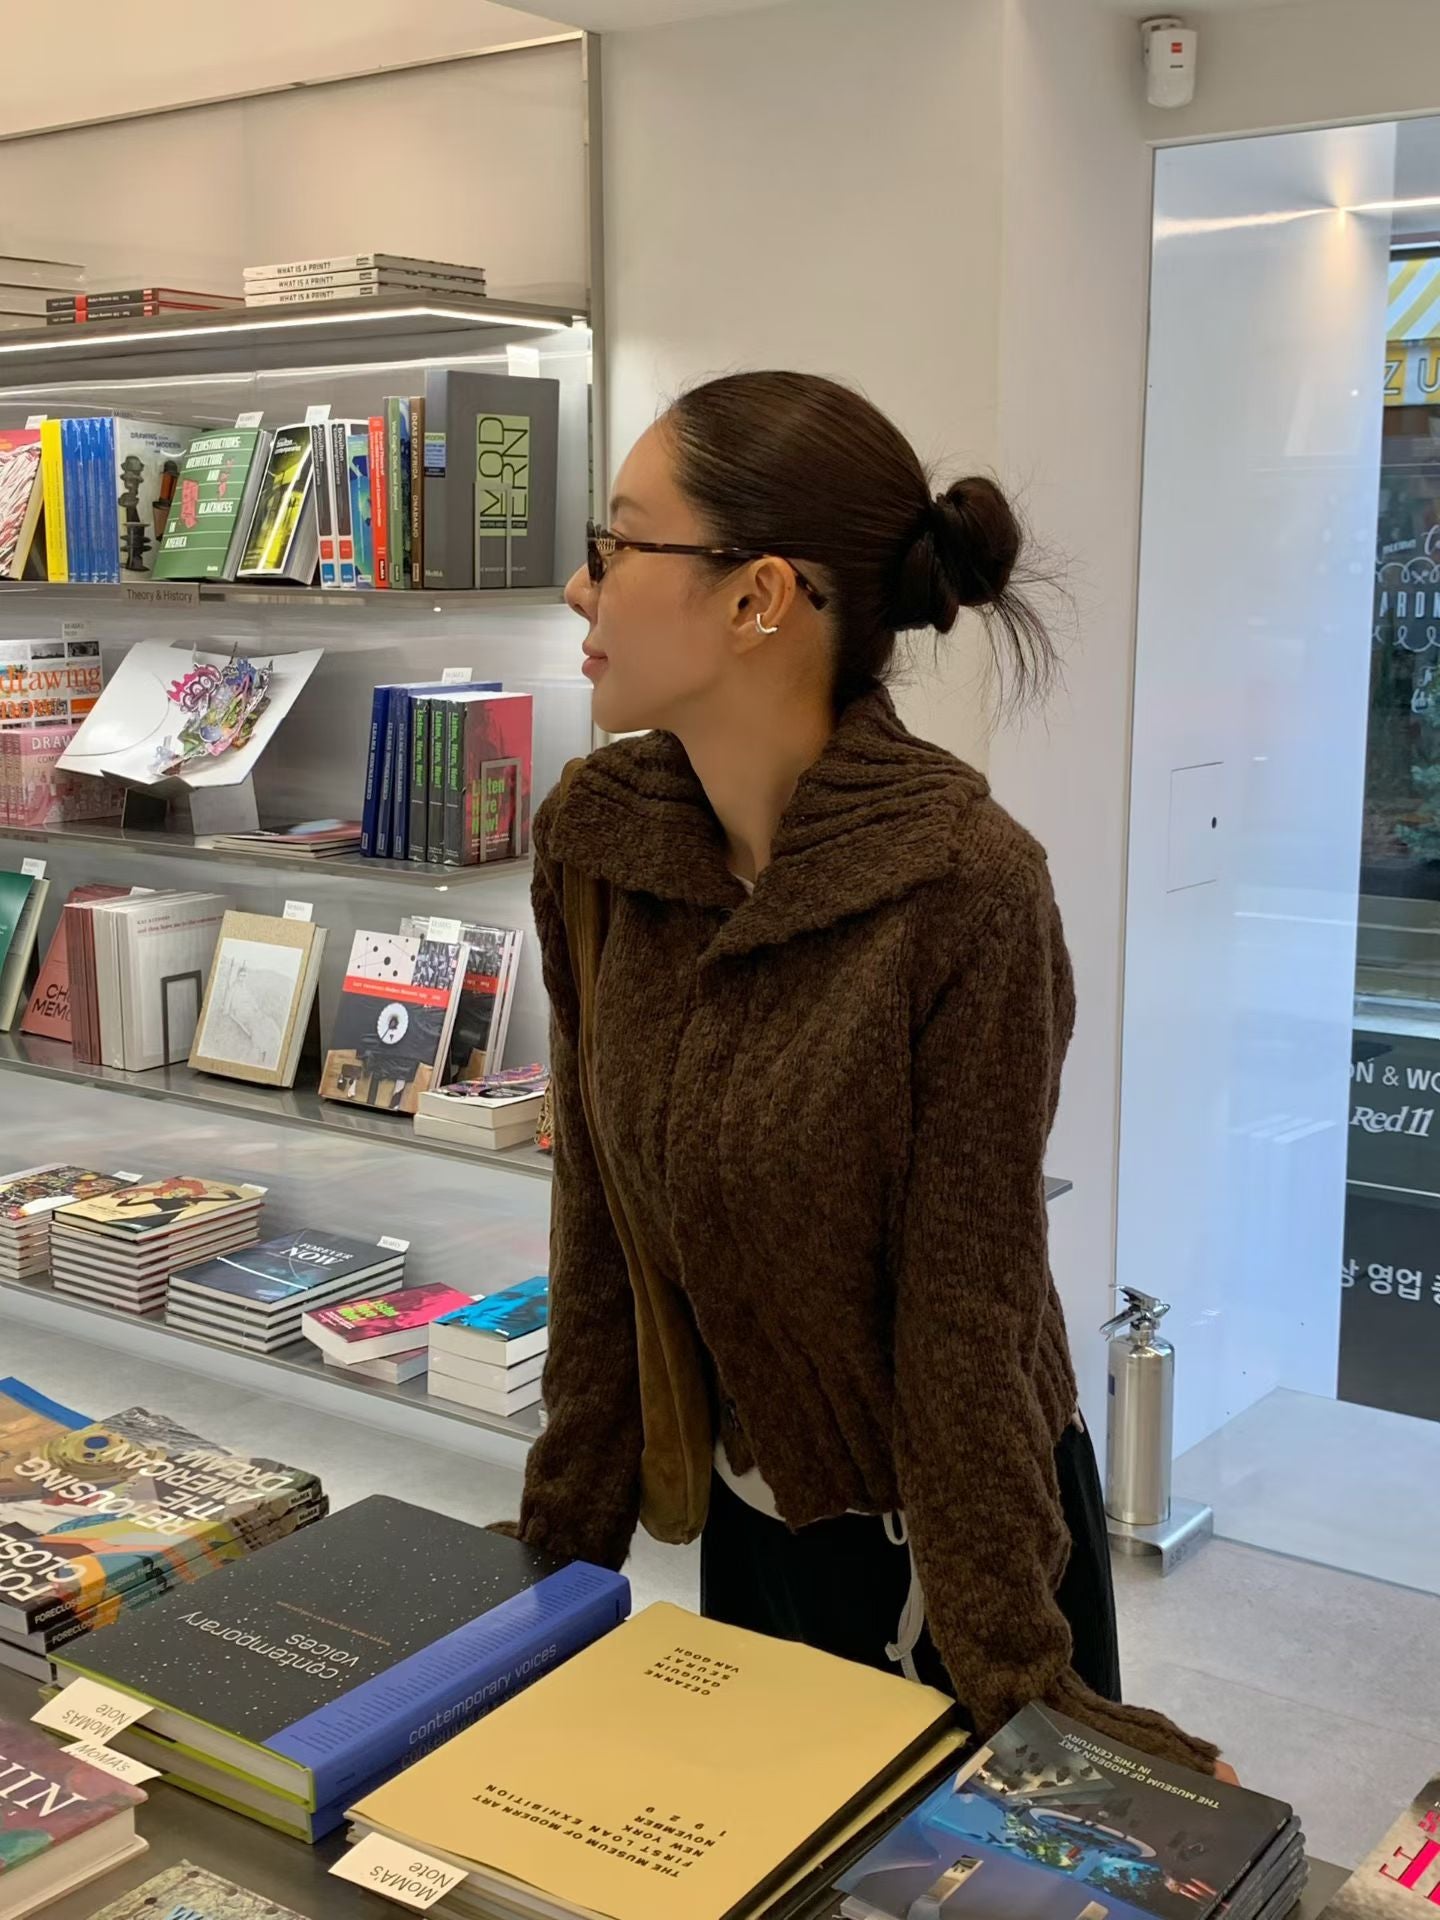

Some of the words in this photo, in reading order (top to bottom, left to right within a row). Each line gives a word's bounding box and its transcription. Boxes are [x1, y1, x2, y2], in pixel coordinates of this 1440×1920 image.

[276, 264, 294, 275] WHAT
[309, 261, 331, 271] PRINT?
[278, 278, 296, 288] WHAT
[311, 275, 334, 285] PRINT?
[312, 290, 334, 299] PRINT?
[186, 453, 224, 468] ARCHITECTURE
[198, 501, 234, 514] BLACKNESS
[165, 536, 187, 549] AMERICA
[127, 588, 153, 603] Theory
[156, 589, 163, 600] &
[163, 589, 193, 602] History
[46, 984, 71, 1002] CH
[1382, 1065, 1400, 1087] &
[280, 1247, 344, 1265] NOW
[299, 1243, 355, 1259] FOREVER
[1367, 1263, 1423, 1302] 영업
[102, 1442, 266, 1505] AMERICAN
[176, 1449, 294, 1493] DREAM
[14, 1456, 192, 1536] REHOUSING
[160, 1491, 225, 1521] THE
[177, 1610, 340, 1680] contemporary
[284, 1633, 360, 1668] voices
[674, 1647, 712, 1663] GOGH
[654, 1661, 721, 1688] GAUGUIN
[663, 1655, 731, 1680] SEURAT
[714, 1661, 740, 1674] VAN
[408, 1671, 512, 1745] contemporary
[515, 1642, 558, 1679] voices
[95, 1703, 132, 1726] Note
[1058, 1739, 1082, 1753] ART
[1064, 1733, 1114, 1760] CENTURY
[1081, 1750, 1131, 1777] MODERN
[1113, 1755, 1139, 1770] THIS
[1139, 1764, 1152, 1775] IN
[1129, 1772, 1145, 1782] OF
[1147, 1777, 1198, 1801] MUSEUM
[472, 1794, 502, 1808] ART
[485, 1784, 583, 1826] EXHIBITION
[1197, 1795, 1220, 1809] THE
[502, 1805, 563, 1832] MODERN
[563, 1829, 583, 1840] OF
[588, 1824, 635, 1847] LOAN
[622, 1824, 662, 1844] YORK
[633, 1815, 716, 1848] NOVEMBER
[585, 1837, 650, 1867] MUSEUM
[640, 1845, 694, 1869] FIRST
[669, 1842, 705, 1858] NEW
[408, 1861, 455, 1889] Note
[651, 1863, 680, 1878] THE
